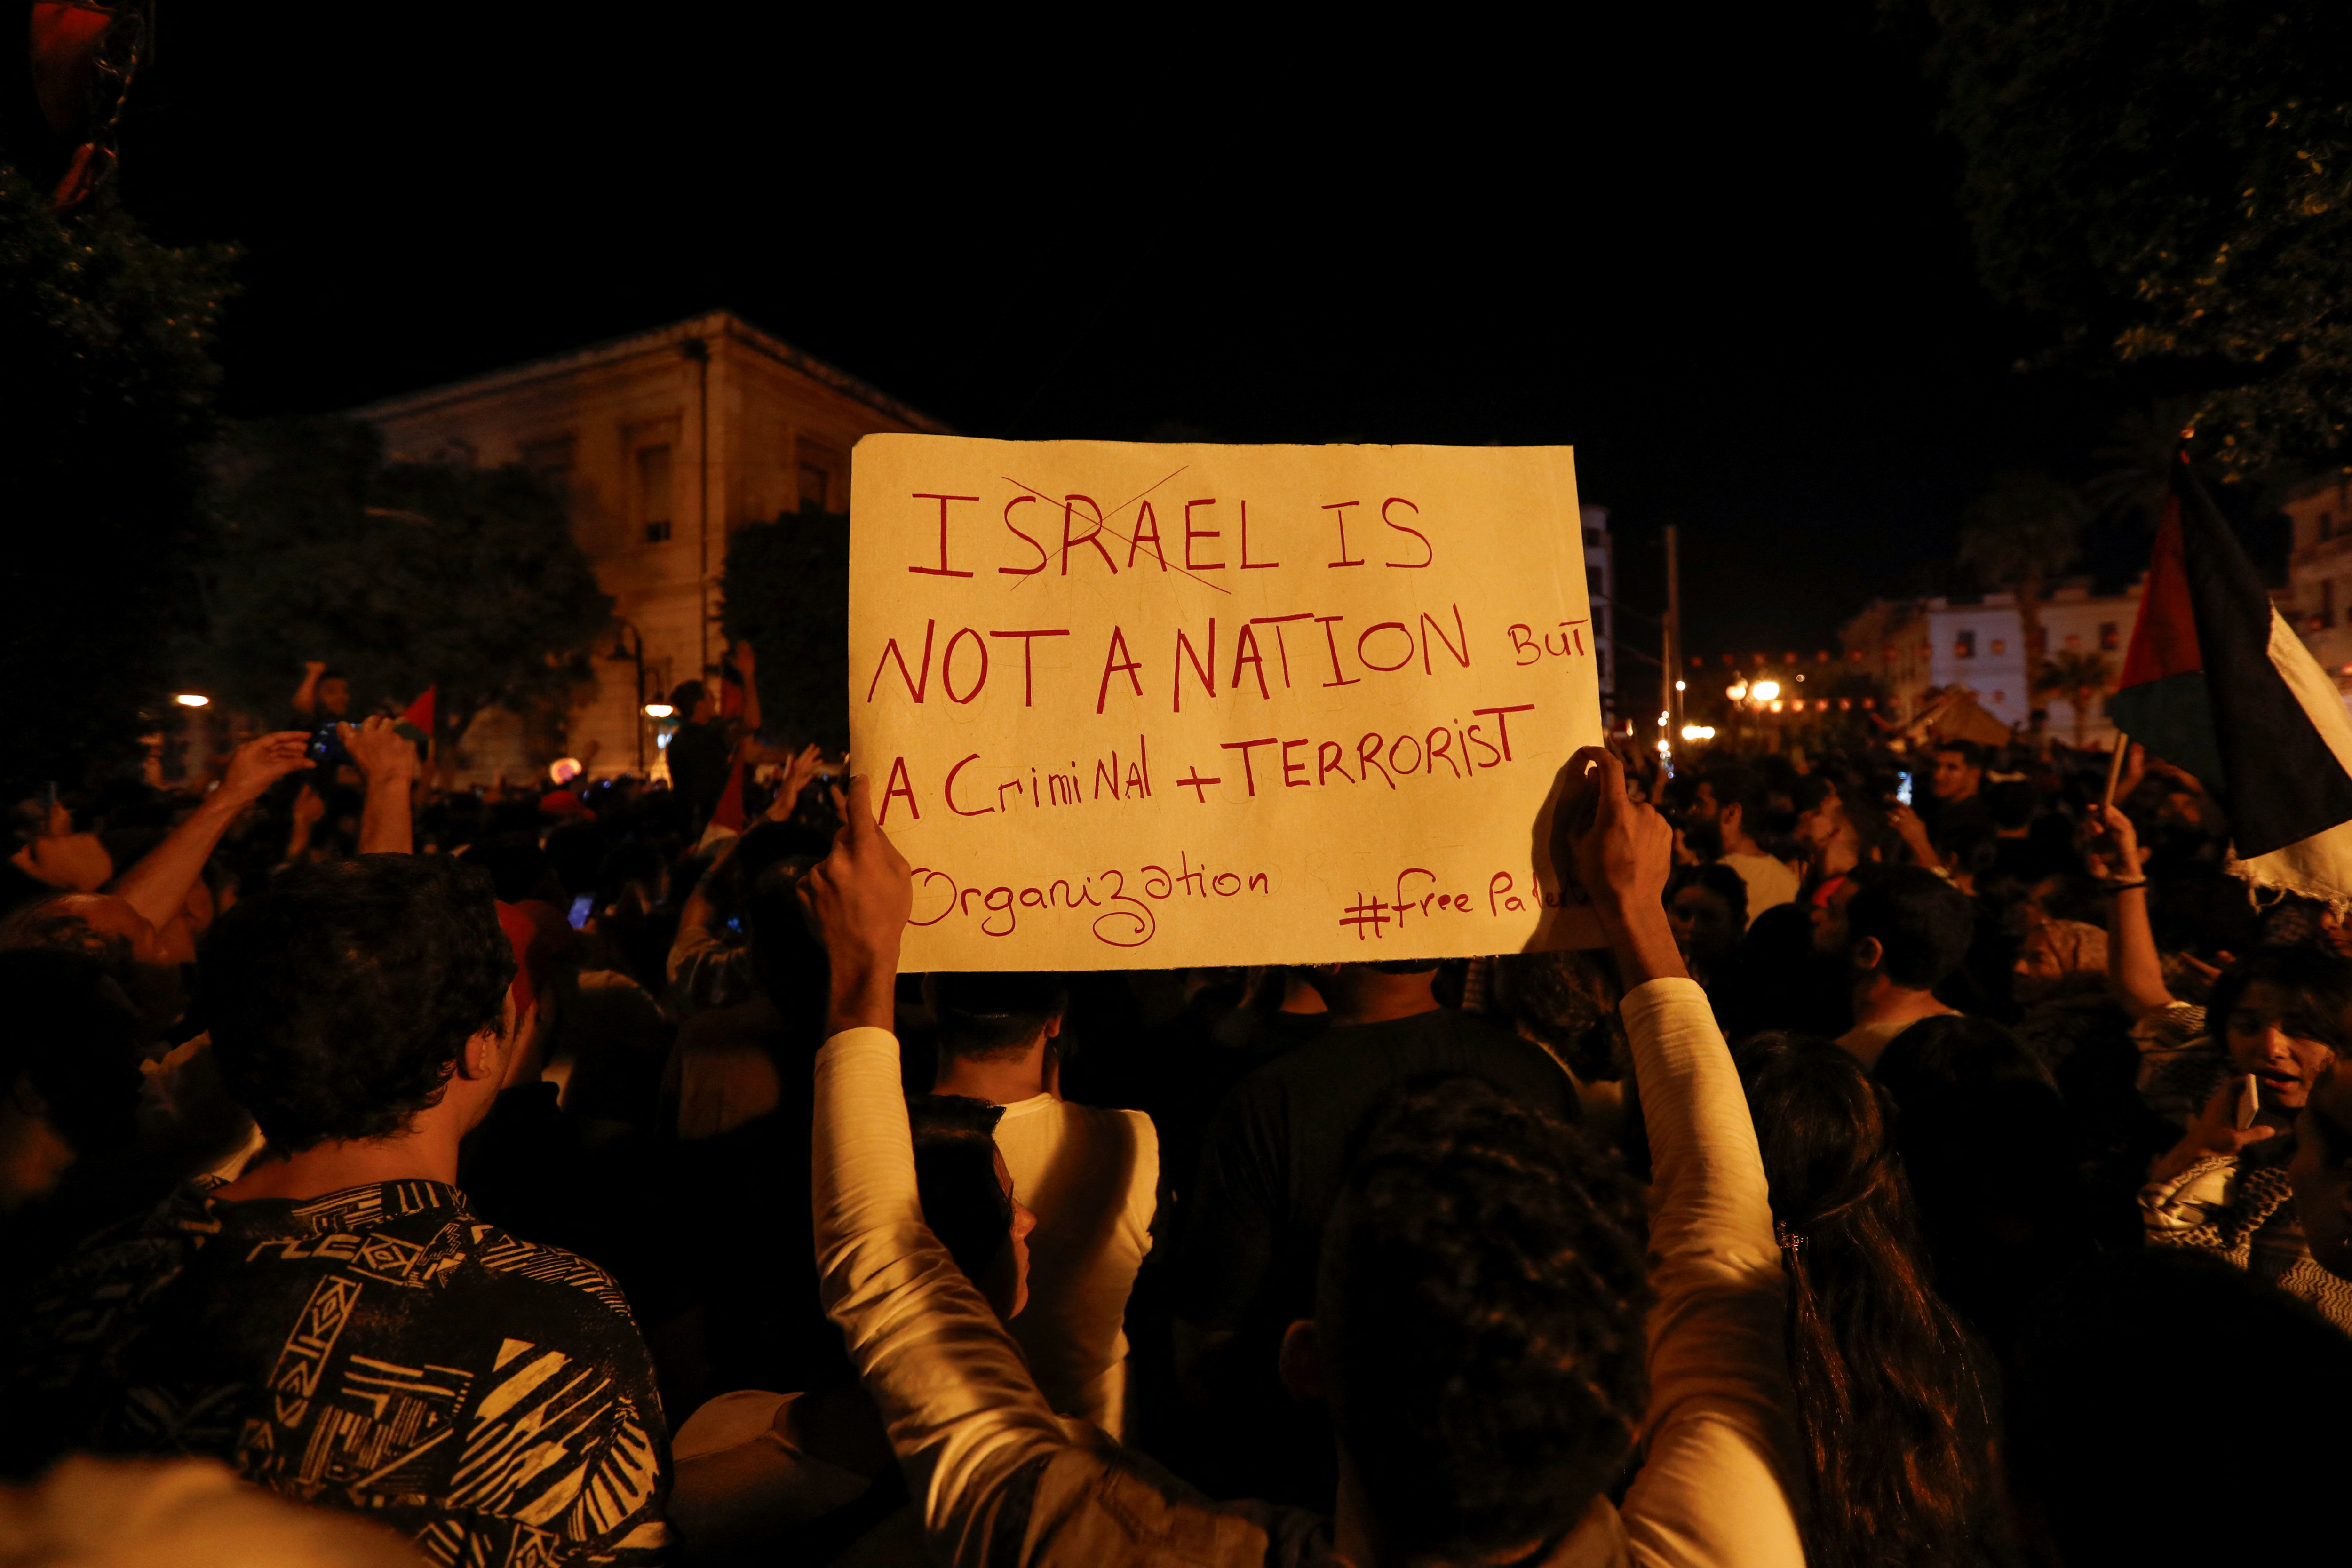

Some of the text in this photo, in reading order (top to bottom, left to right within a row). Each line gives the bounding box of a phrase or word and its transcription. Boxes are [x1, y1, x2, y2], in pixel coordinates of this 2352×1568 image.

[909, 492, 1432, 578] ISRAEL IS
[867, 619, 1070, 707] NOT
[1097, 626, 1143, 714] A
[1174, 603, 1470, 713] NATION
[878, 756, 920, 826] A
[908, 850, 1269, 947] Organization
[1489, 870, 1592, 917] Palest
